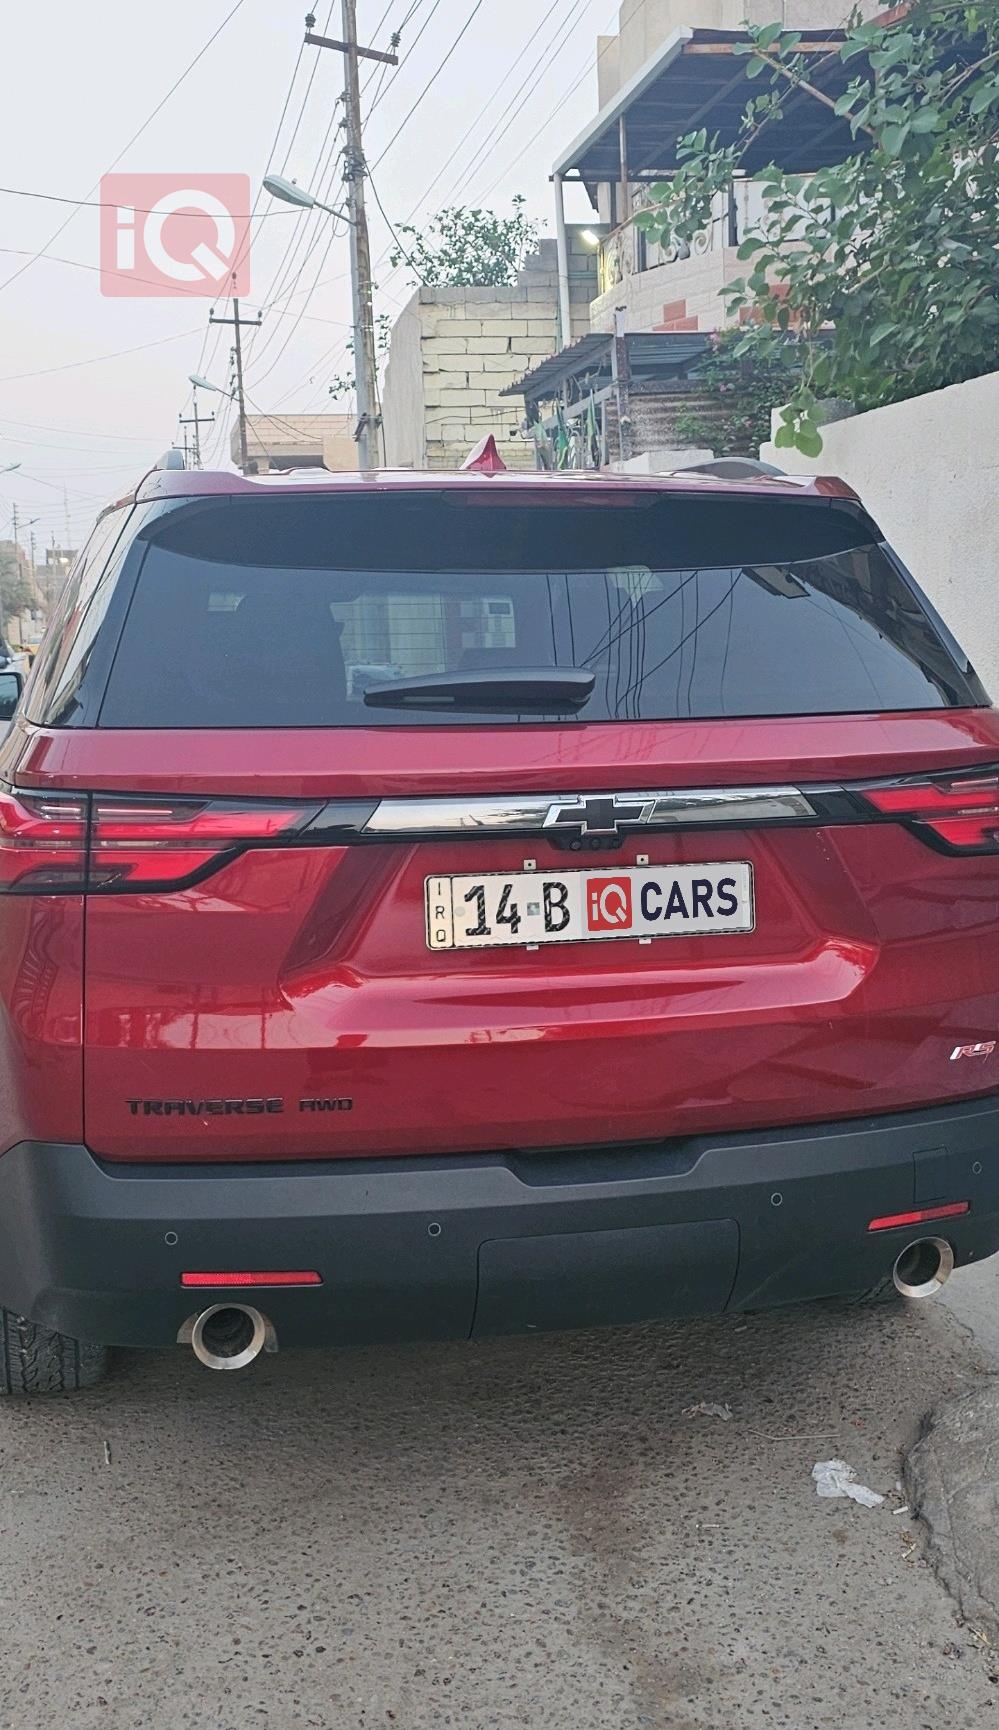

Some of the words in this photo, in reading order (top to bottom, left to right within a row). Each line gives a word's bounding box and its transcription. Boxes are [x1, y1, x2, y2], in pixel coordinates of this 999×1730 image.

[464, 882, 521, 936] 14
[543, 881, 571, 933] B
[125, 1097, 285, 1116] TRAVERSE
[299, 1097, 353, 1112] AWD
